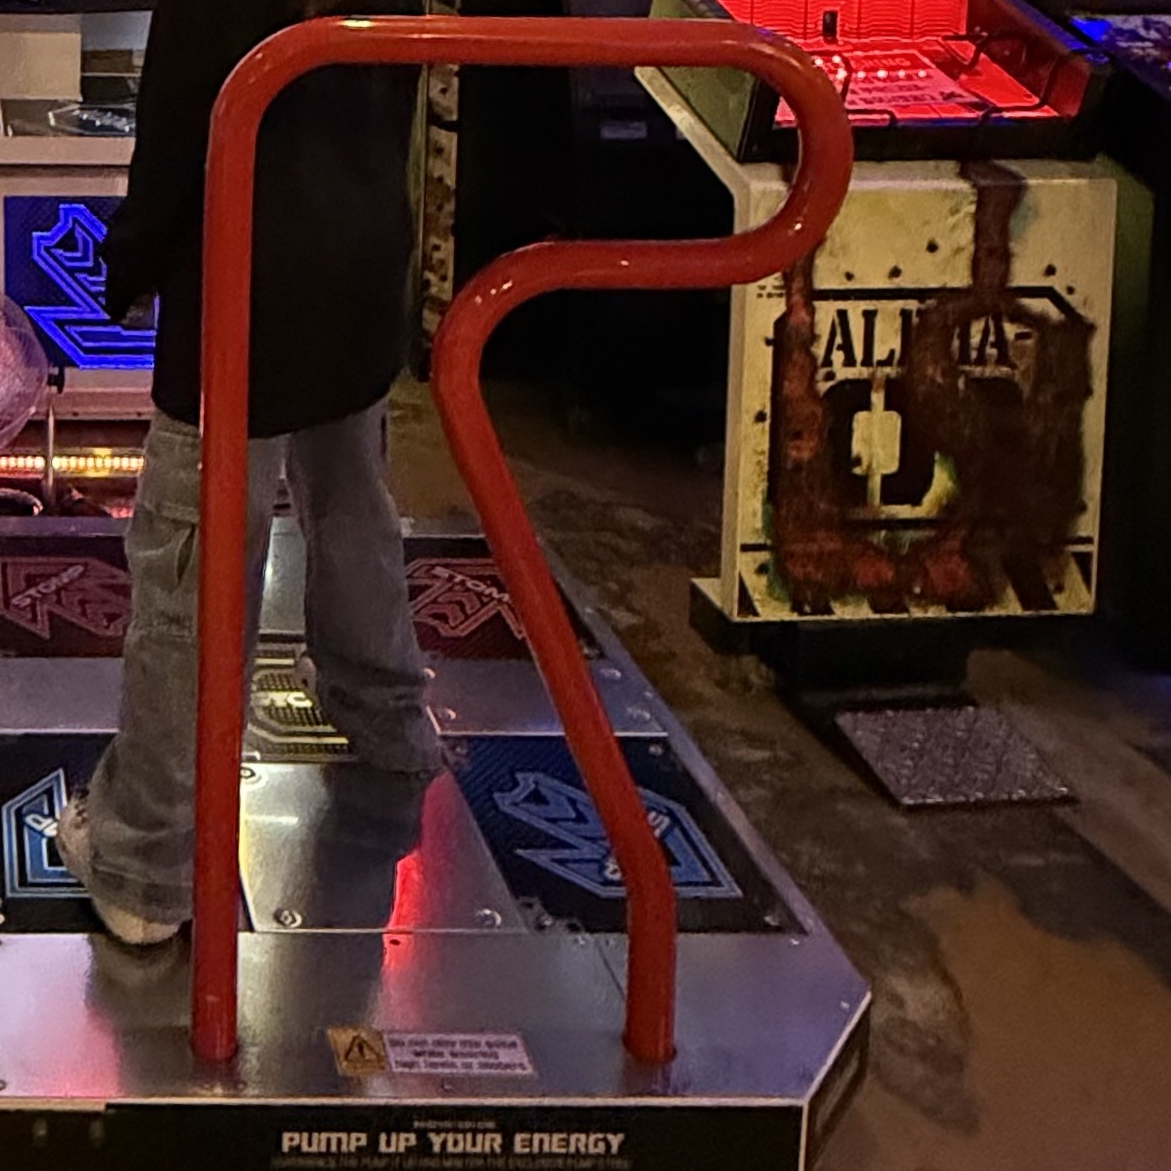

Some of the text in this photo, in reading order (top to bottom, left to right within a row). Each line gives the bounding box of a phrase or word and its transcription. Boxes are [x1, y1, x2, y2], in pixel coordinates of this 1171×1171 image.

[431, 565, 510, 604] STOM
[281, 1132, 625, 1154] PUMP UP YOUR ENERGY
